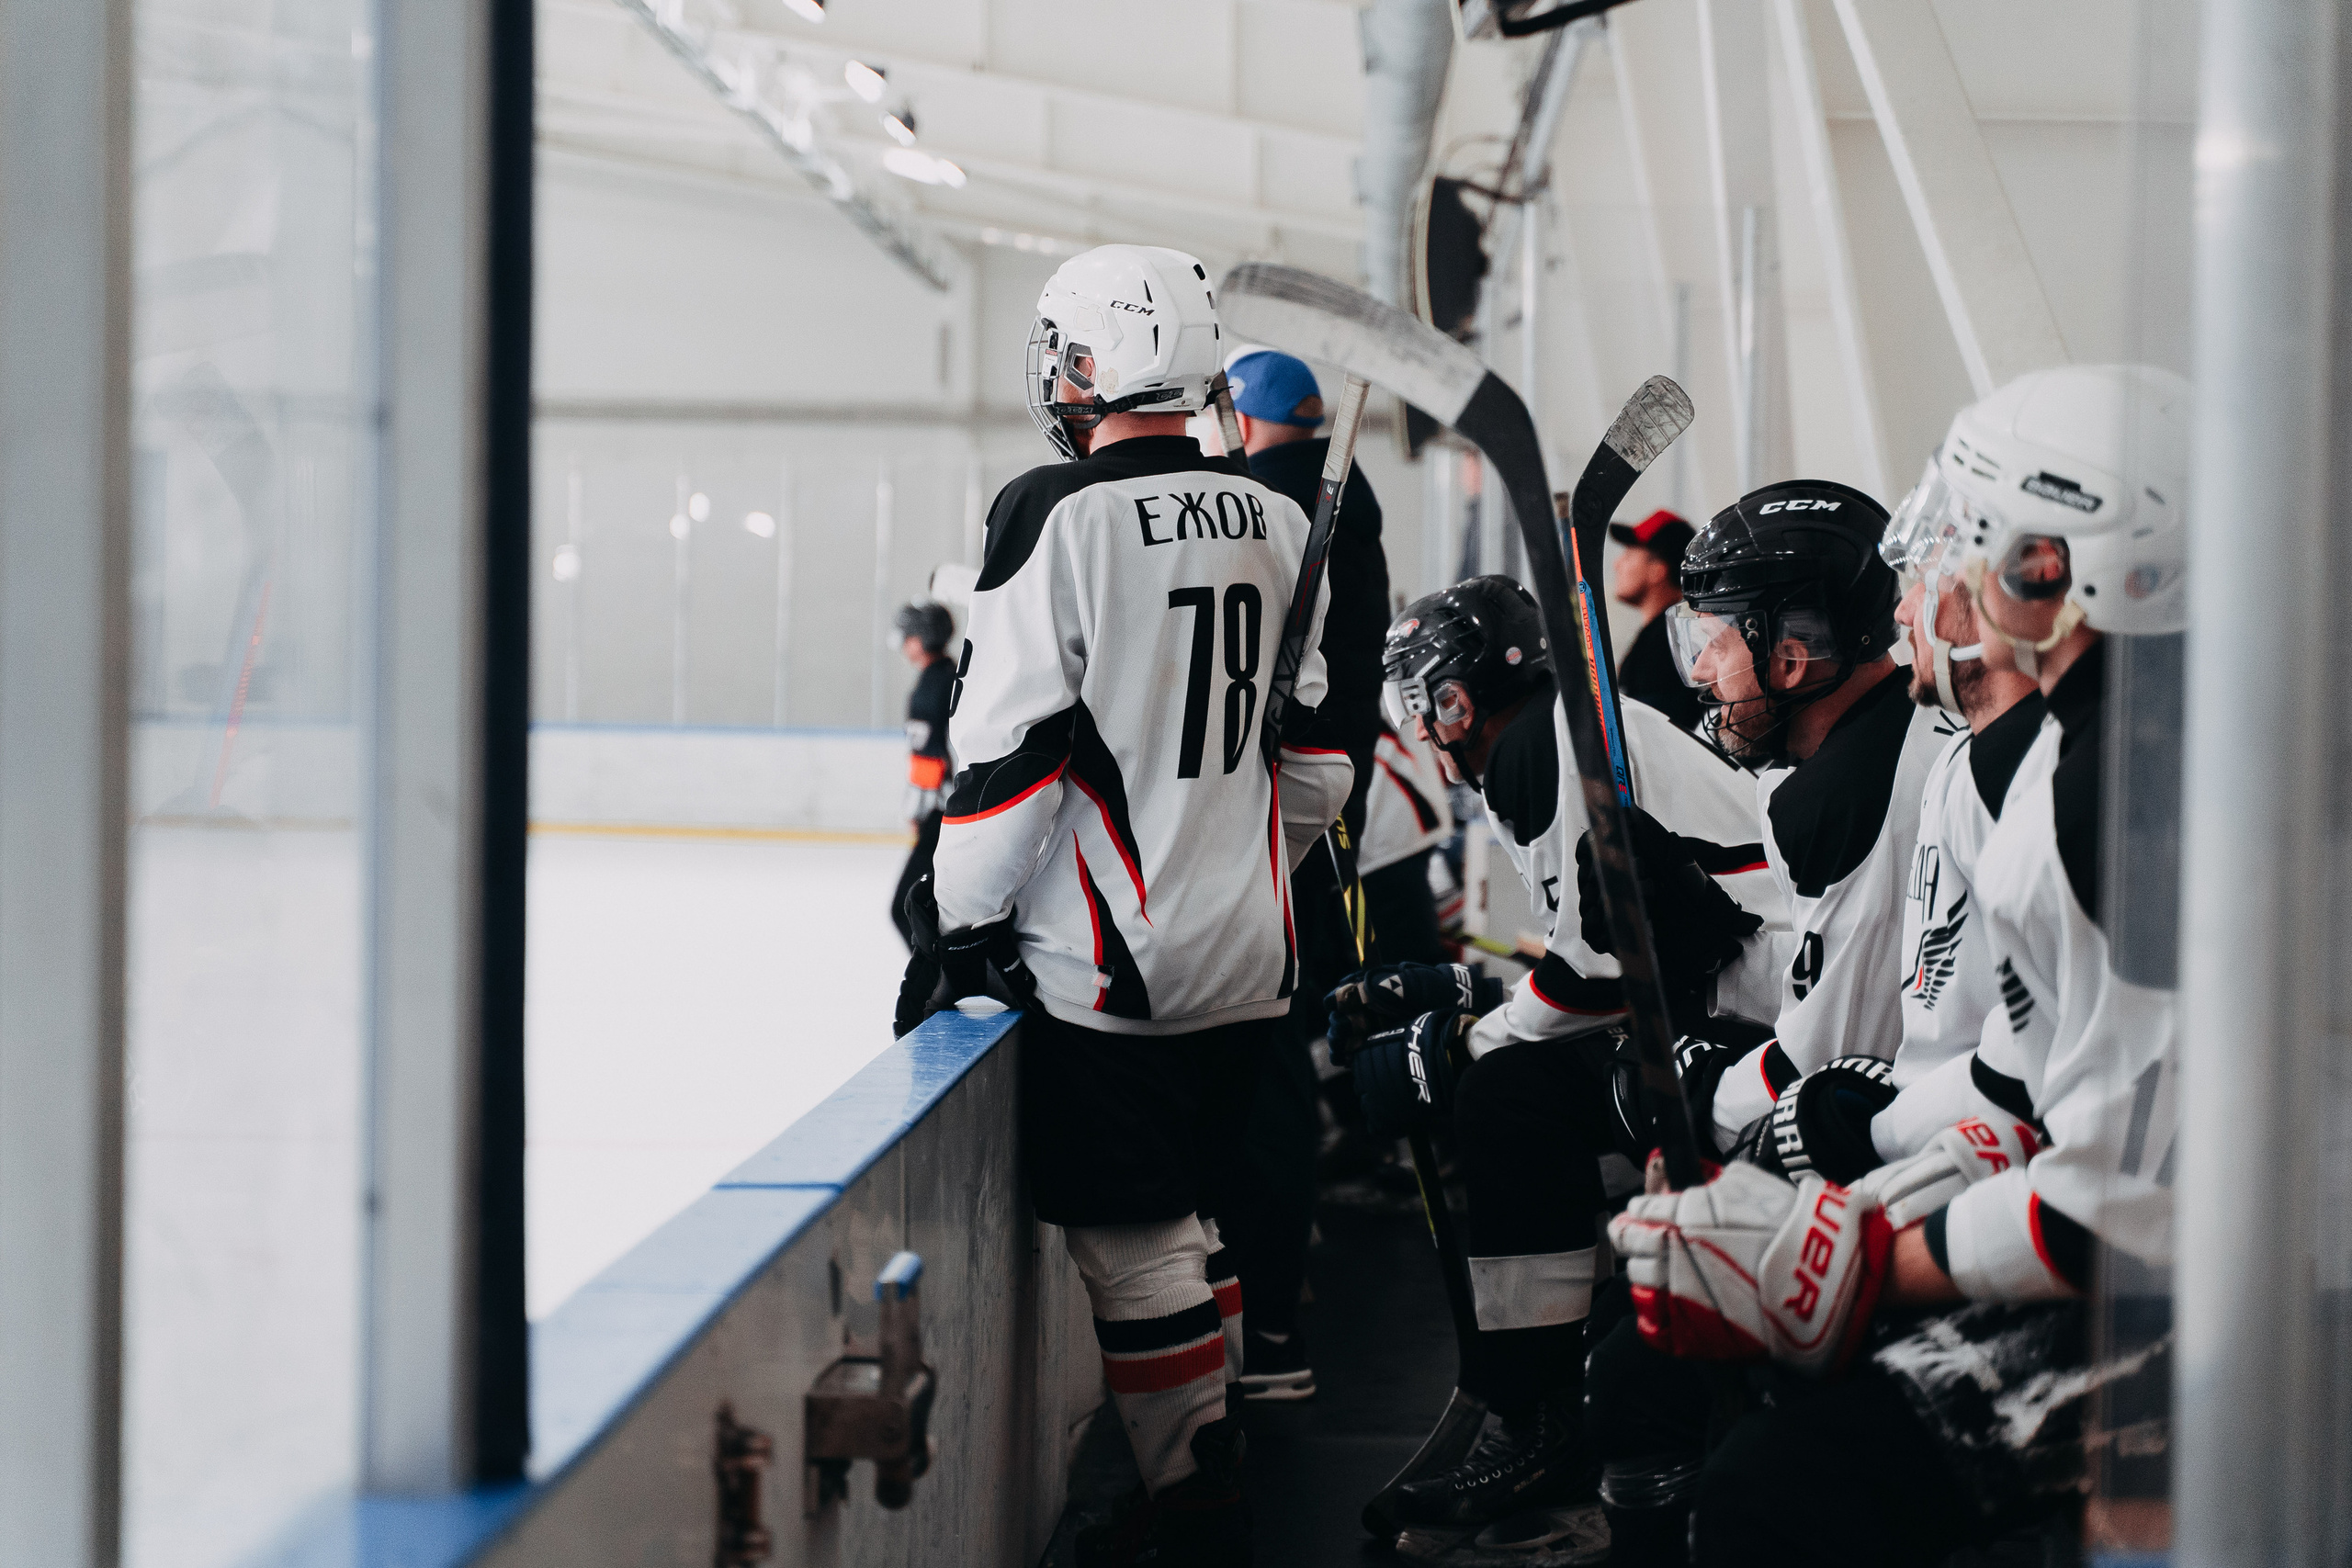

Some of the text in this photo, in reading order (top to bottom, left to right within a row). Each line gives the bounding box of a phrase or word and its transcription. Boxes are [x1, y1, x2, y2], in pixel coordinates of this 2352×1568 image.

[1110, 299, 1156, 317] CCM
[1134, 491, 1268, 547] ЕЖОВ
[1758, 500, 1842, 515] CCM
[1168, 582, 1262, 780] 78
